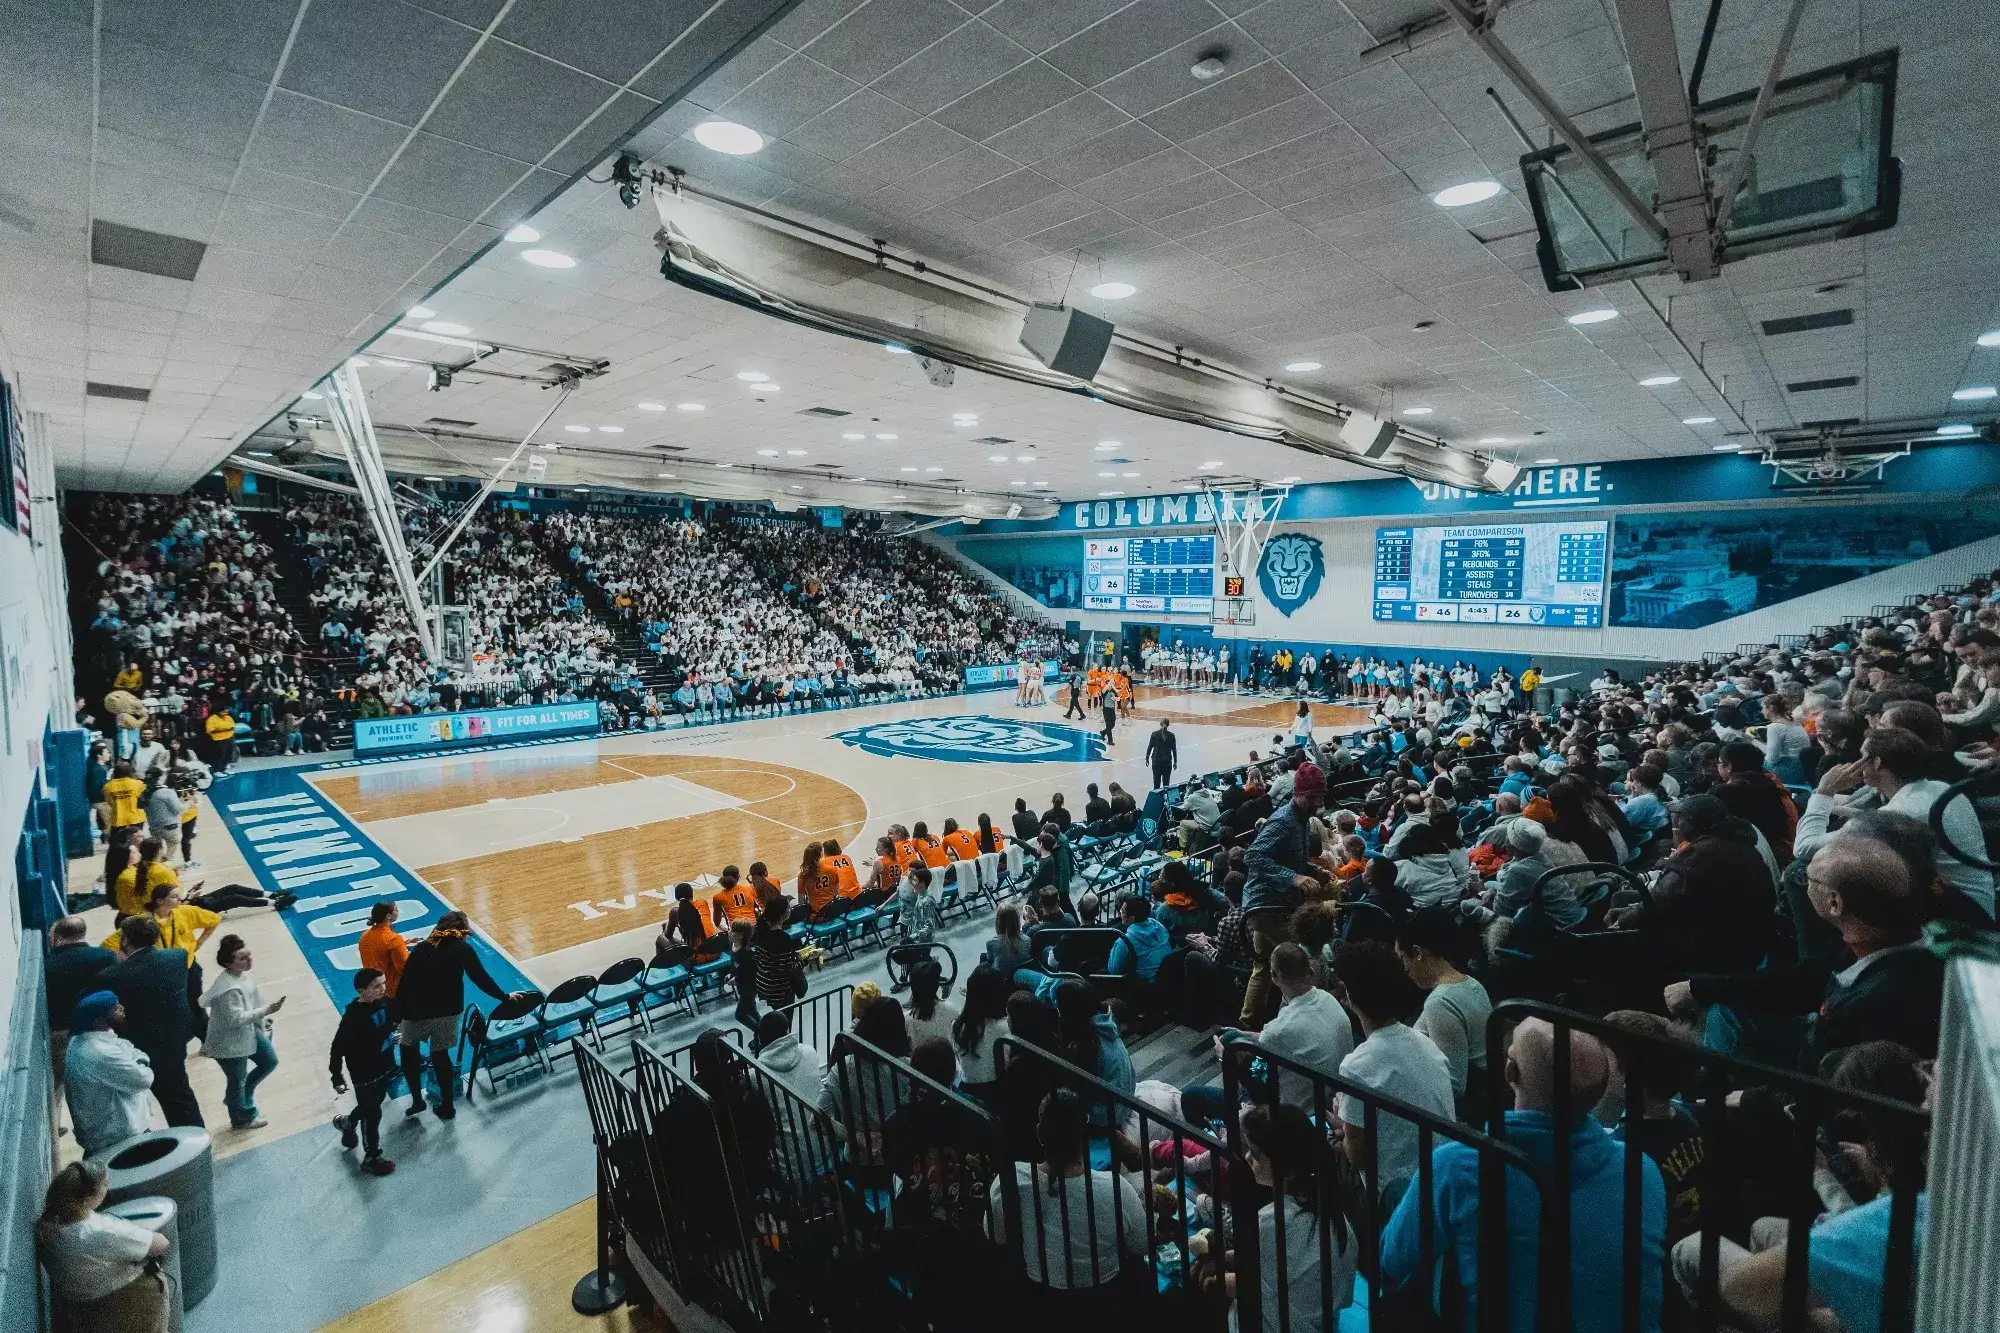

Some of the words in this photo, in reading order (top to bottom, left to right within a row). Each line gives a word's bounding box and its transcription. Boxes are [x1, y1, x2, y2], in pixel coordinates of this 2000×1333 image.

[1514, 466, 1614, 496] HERE.
[586, 504, 638, 514] COLUMBIA
[1075, 490, 1264, 528] COLUMBIA
[1443, 529, 1464, 537] TEAM
[1467, 527, 1524, 537] COMPARISON
[1107, 545, 1119, 553] 46
[1471, 550, 1490, 558] 3FG%
[1228, 584, 1239, 595] 30
[1460, 590, 1498, 599] TURNOVERS
[498, 716, 514, 728] FIT
[517, 714, 537, 727] FOR
[540, 712, 558, 724] ALL
[560, 710, 590, 722] TIMES
[369, 723, 418, 736] ATHLETIC
[378, 735, 404, 743] BREWING
[927, 839, 940, 850] 33
[961, 834, 970, 844] 5
[833, 857, 850, 869] 44
[733, 892, 748, 908] 11
